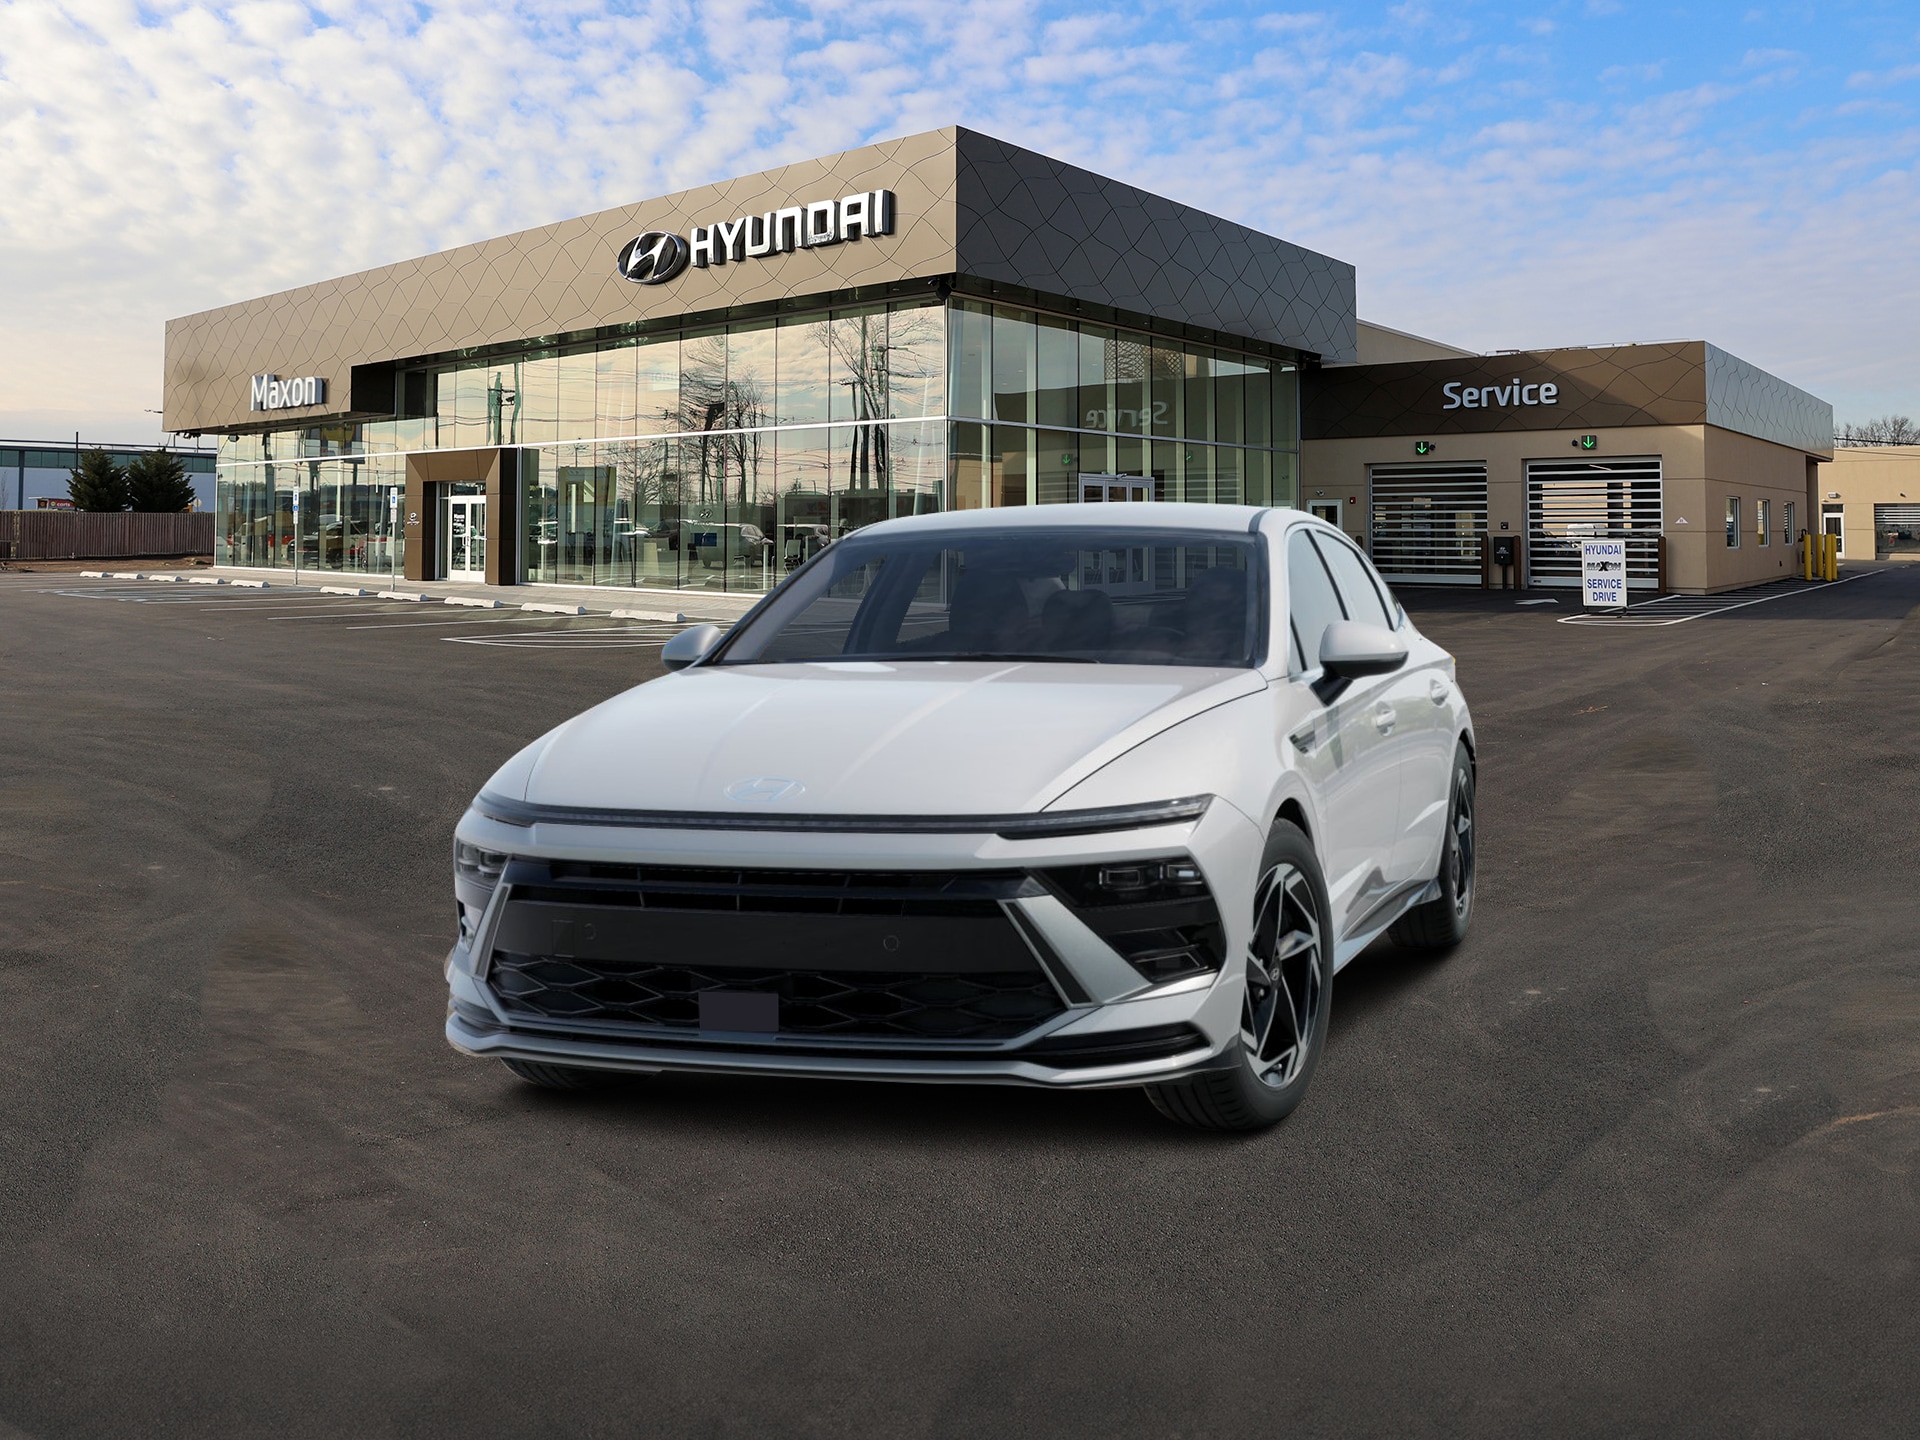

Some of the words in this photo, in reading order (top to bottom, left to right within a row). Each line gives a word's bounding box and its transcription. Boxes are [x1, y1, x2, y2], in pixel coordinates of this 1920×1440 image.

[690, 189, 888, 268] HYUNDAI
[250, 373, 317, 411] Maxon
[1443, 378, 1558, 409] Service
[1585, 545, 1622, 555] HYUNDAI
[1586, 561, 1622, 572] MAXON
[1587, 579, 1622, 589] SERVICE
[1593, 592, 1617, 602] DRIVE
